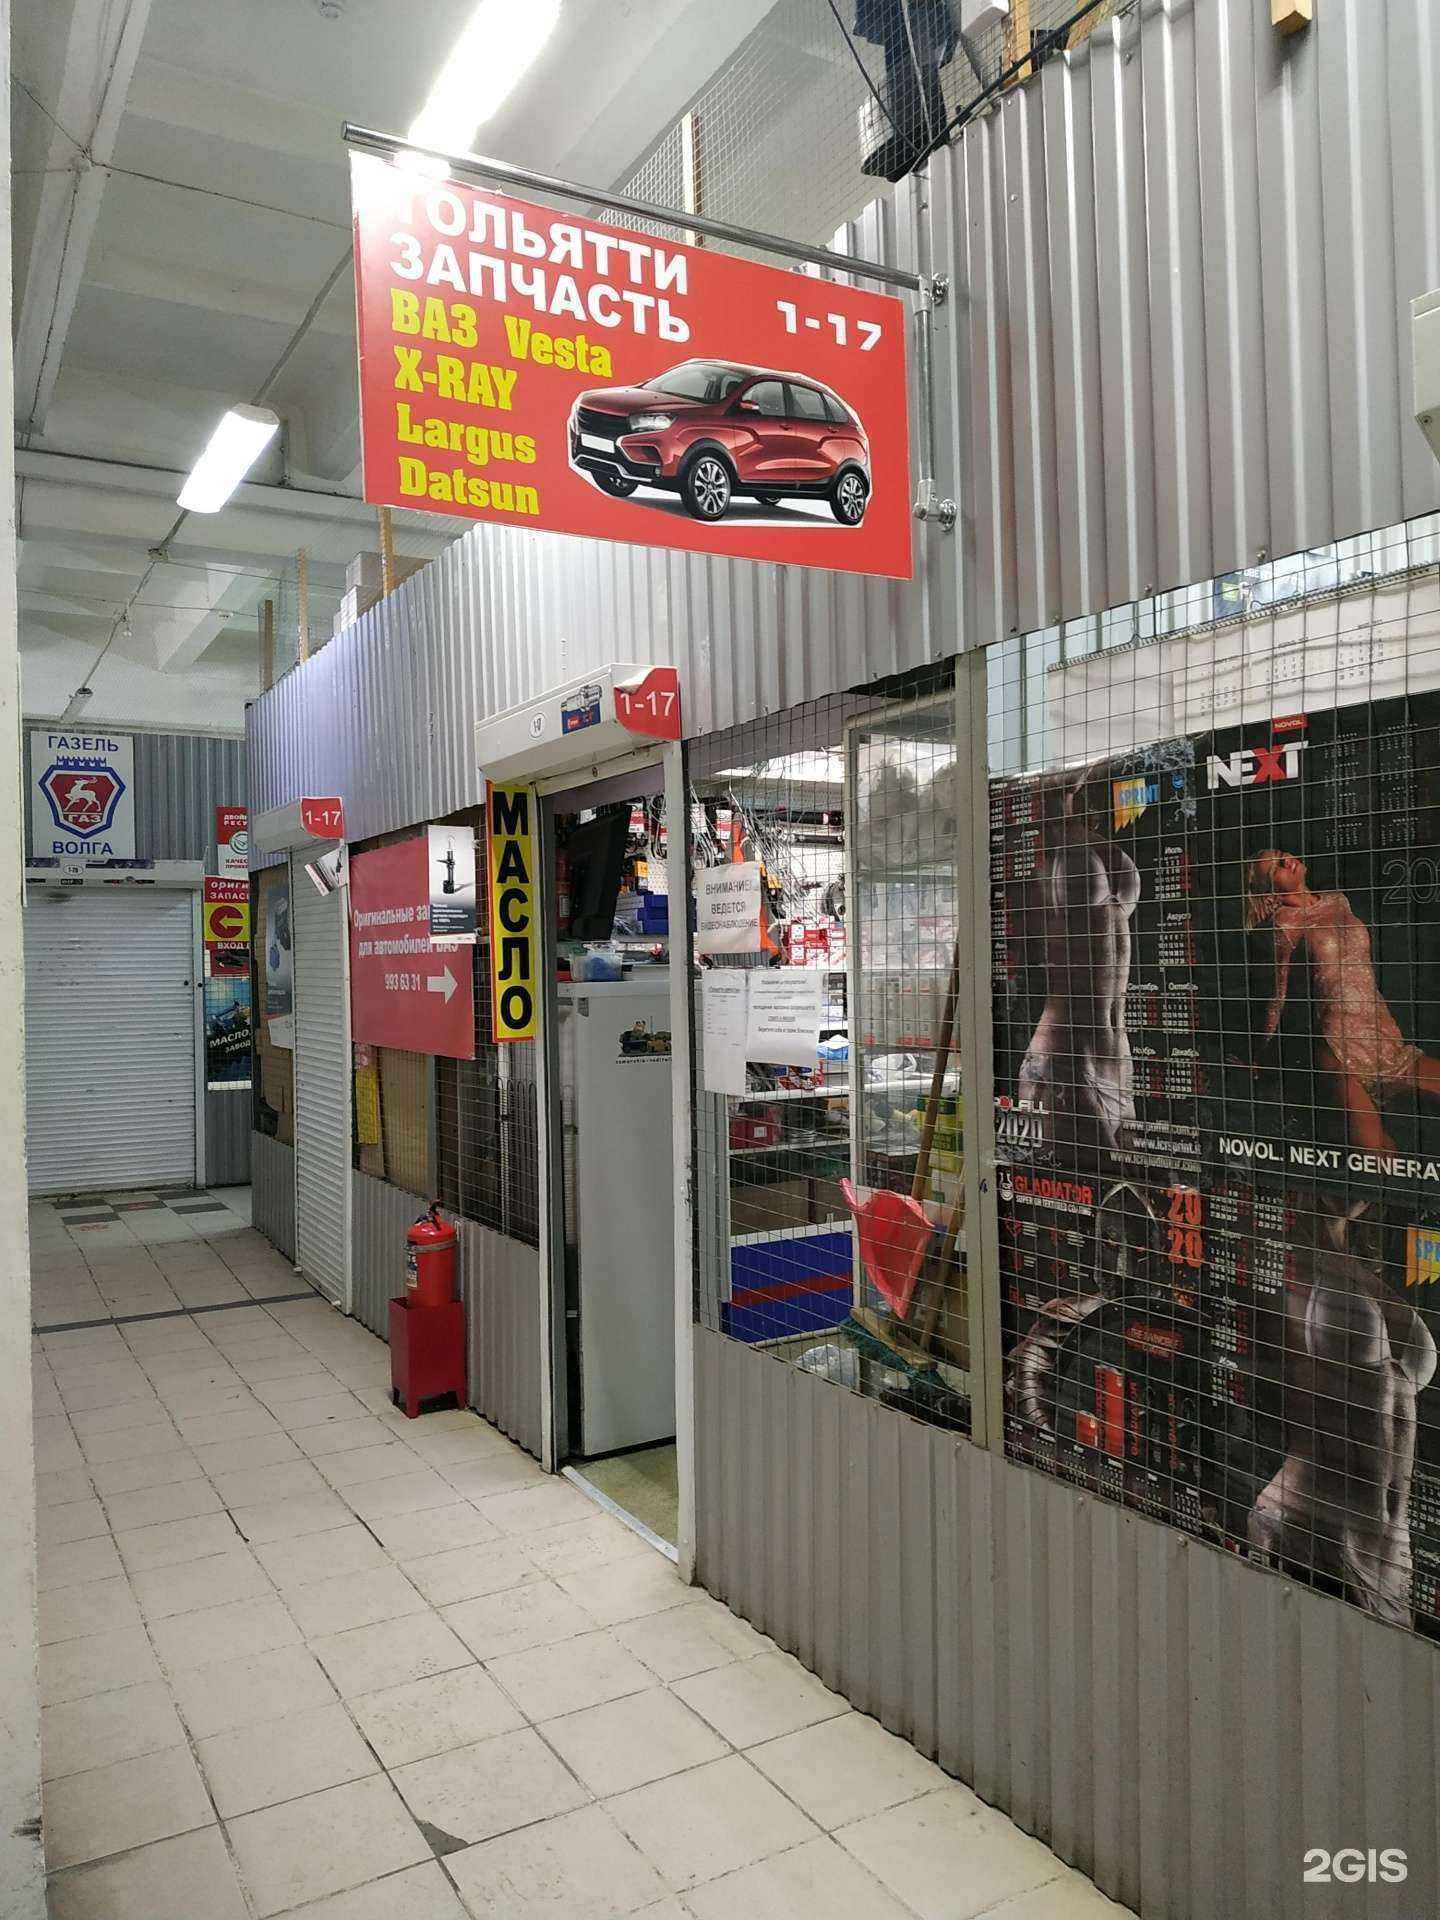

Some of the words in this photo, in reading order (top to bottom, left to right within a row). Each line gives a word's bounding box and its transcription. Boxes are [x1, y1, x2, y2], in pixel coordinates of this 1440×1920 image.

[389, 231, 692, 343] ЗАПЧАСТЬ
[390, 287, 480, 349] ВАЗ
[503, 315, 614, 379] Vesta
[776, 300, 882, 352] 1-17
[392, 345, 518, 412] X-RAY
[396, 402, 537, 467] Largus
[398, 456, 540, 516] Datsun
[620, 690, 675, 717] 1-17
[1273, 717, 1304, 730] NOVOL
[48, 735, 119, 752] ГАЗЕЛЬ
[1206, 740, 1309, 790] NEXT
[68, 814, 102, 823] ГАЗ
[305, 809, 341, 826] 1-17
[52, 840, 114, 855] ВОЛГА
[1382, 857, 1440, 906] 20
[353, 907, 414, 932] Оригинальные
[491, 790, 533, 1031] МАСЛО
[217, 942, 242, 950] ВХОД
[359, 940, 372, 959] для
[995, 1111, 1043, 1149] 2020
[1219, 1136, 1284, 1161] NOVOL.
[1290, 1145, 1341, 1169] NEXT
[1347, 1153, 1440, 1182] GENERA
[1014, 1174, 1094, 1206] GLADIATOR
